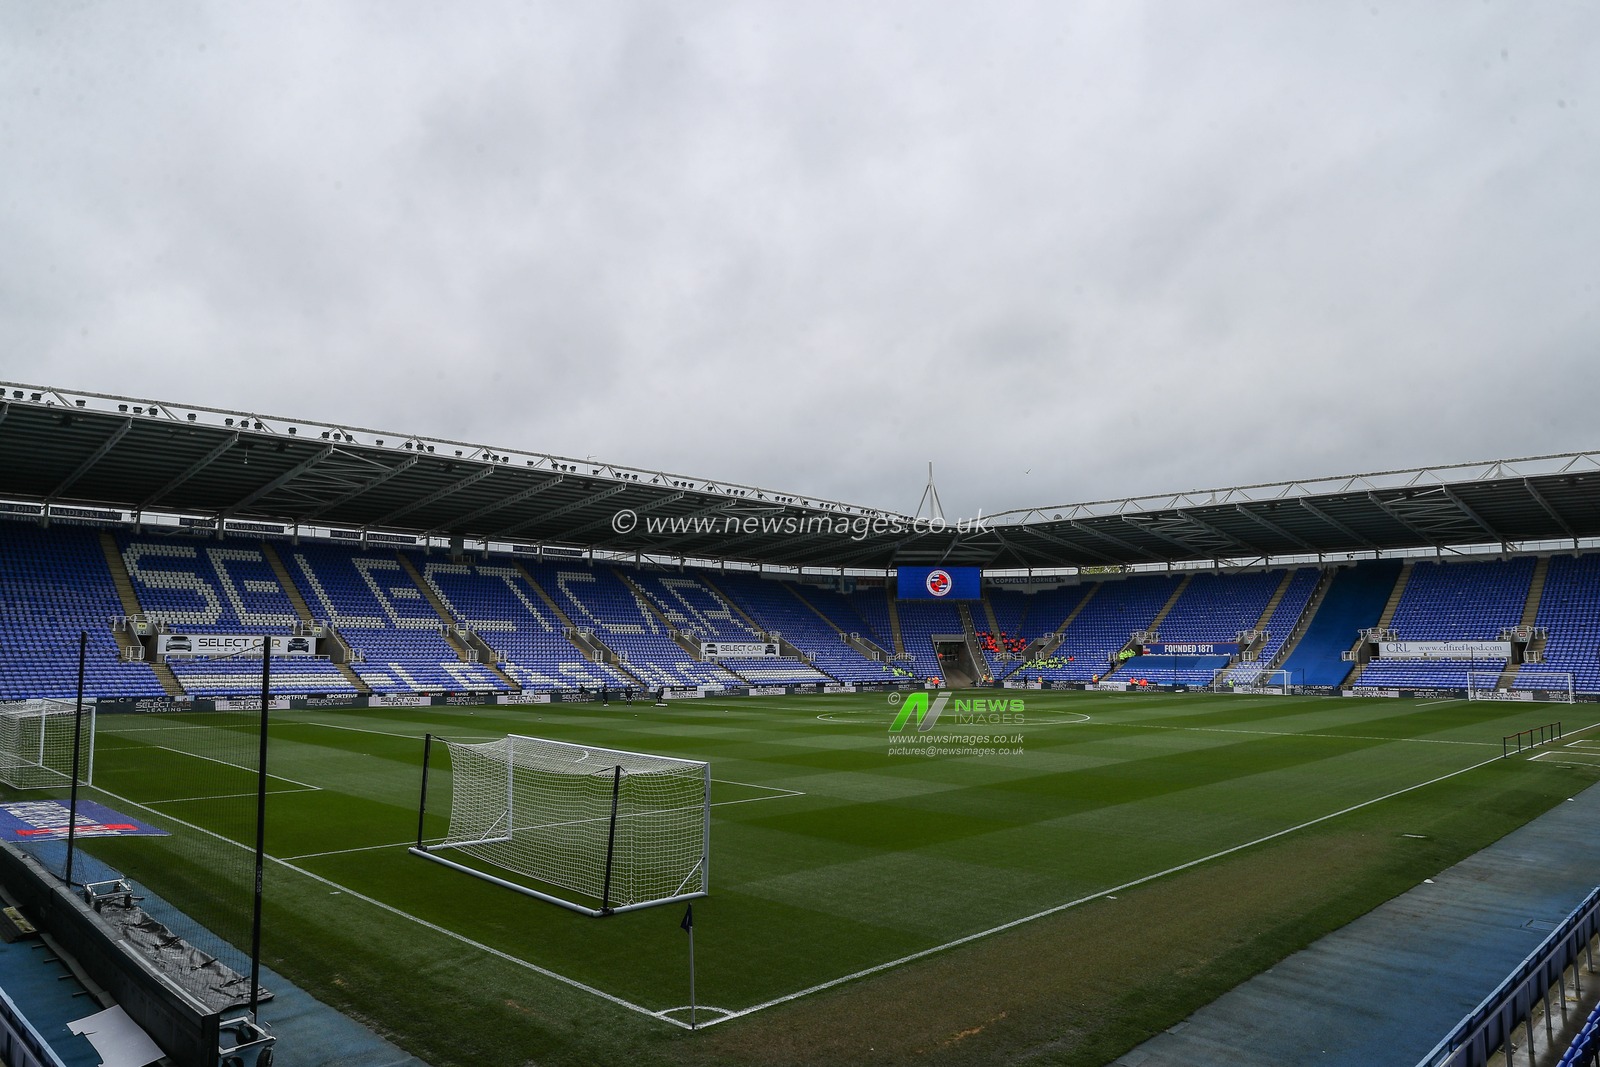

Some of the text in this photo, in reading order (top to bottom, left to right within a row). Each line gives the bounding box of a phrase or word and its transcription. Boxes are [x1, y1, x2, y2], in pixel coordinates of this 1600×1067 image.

[50, 507, 100, 518] MADEJSKI
[198, 638, 281, 648] SELECT CR
[720, 644, 763, 652] SELECT CAR
[1386, 643, 1503, 653] CRL www.crlfireflood.com
[1164, 644, 1214, 653] FOUNDED 1871
